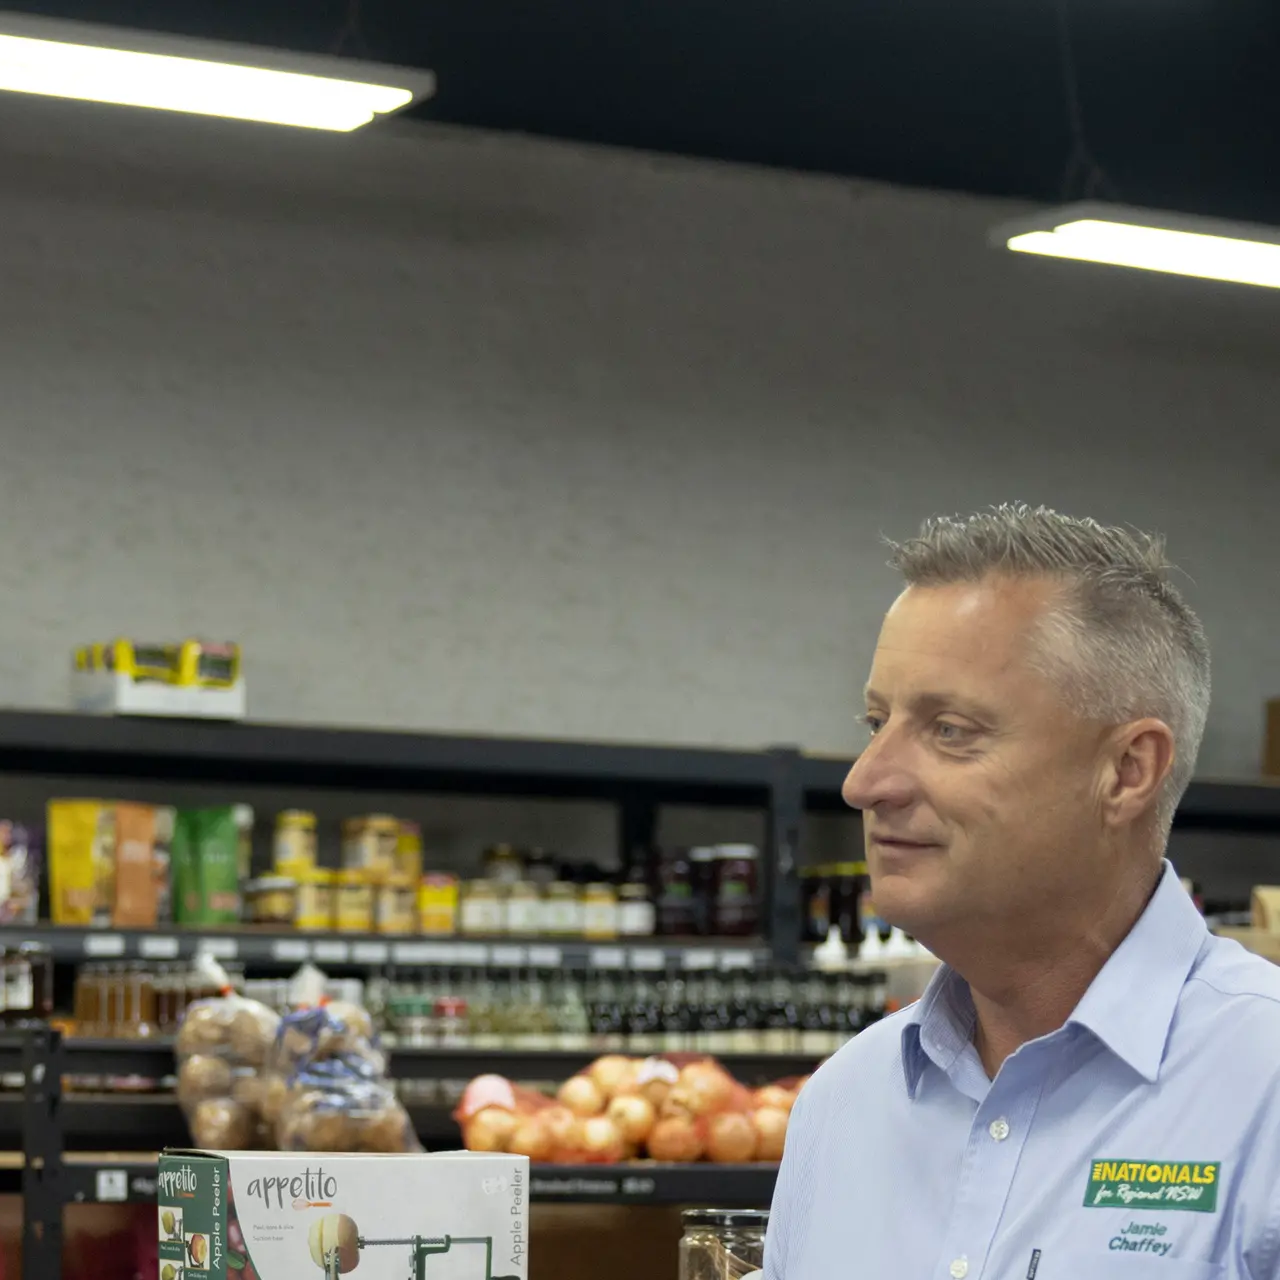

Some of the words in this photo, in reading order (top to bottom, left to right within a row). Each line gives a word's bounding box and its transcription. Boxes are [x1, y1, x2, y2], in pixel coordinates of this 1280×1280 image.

[159, 1165, 197, 1197] appetito
[247, 1167, 338, 1209] appetito
[510, 1168, 522, 1215] Peeler
[1101, 1162, 1216, 1184] NATIONALS
[212, 1167, 221, 1217] Peeler
[1093, 1184, 1114, 1205] for
[1116, 1183, 1165, 1204] Regional
[1165, 1185, 1204, 1202] NSW
[213, 1222, 222, 1270] Apple
[510, 1222, 525, 1266] Apple
[1108, 1236, 1173, 1257] Chaffey
[1121, 1221, 1168, 1236] Jamie
